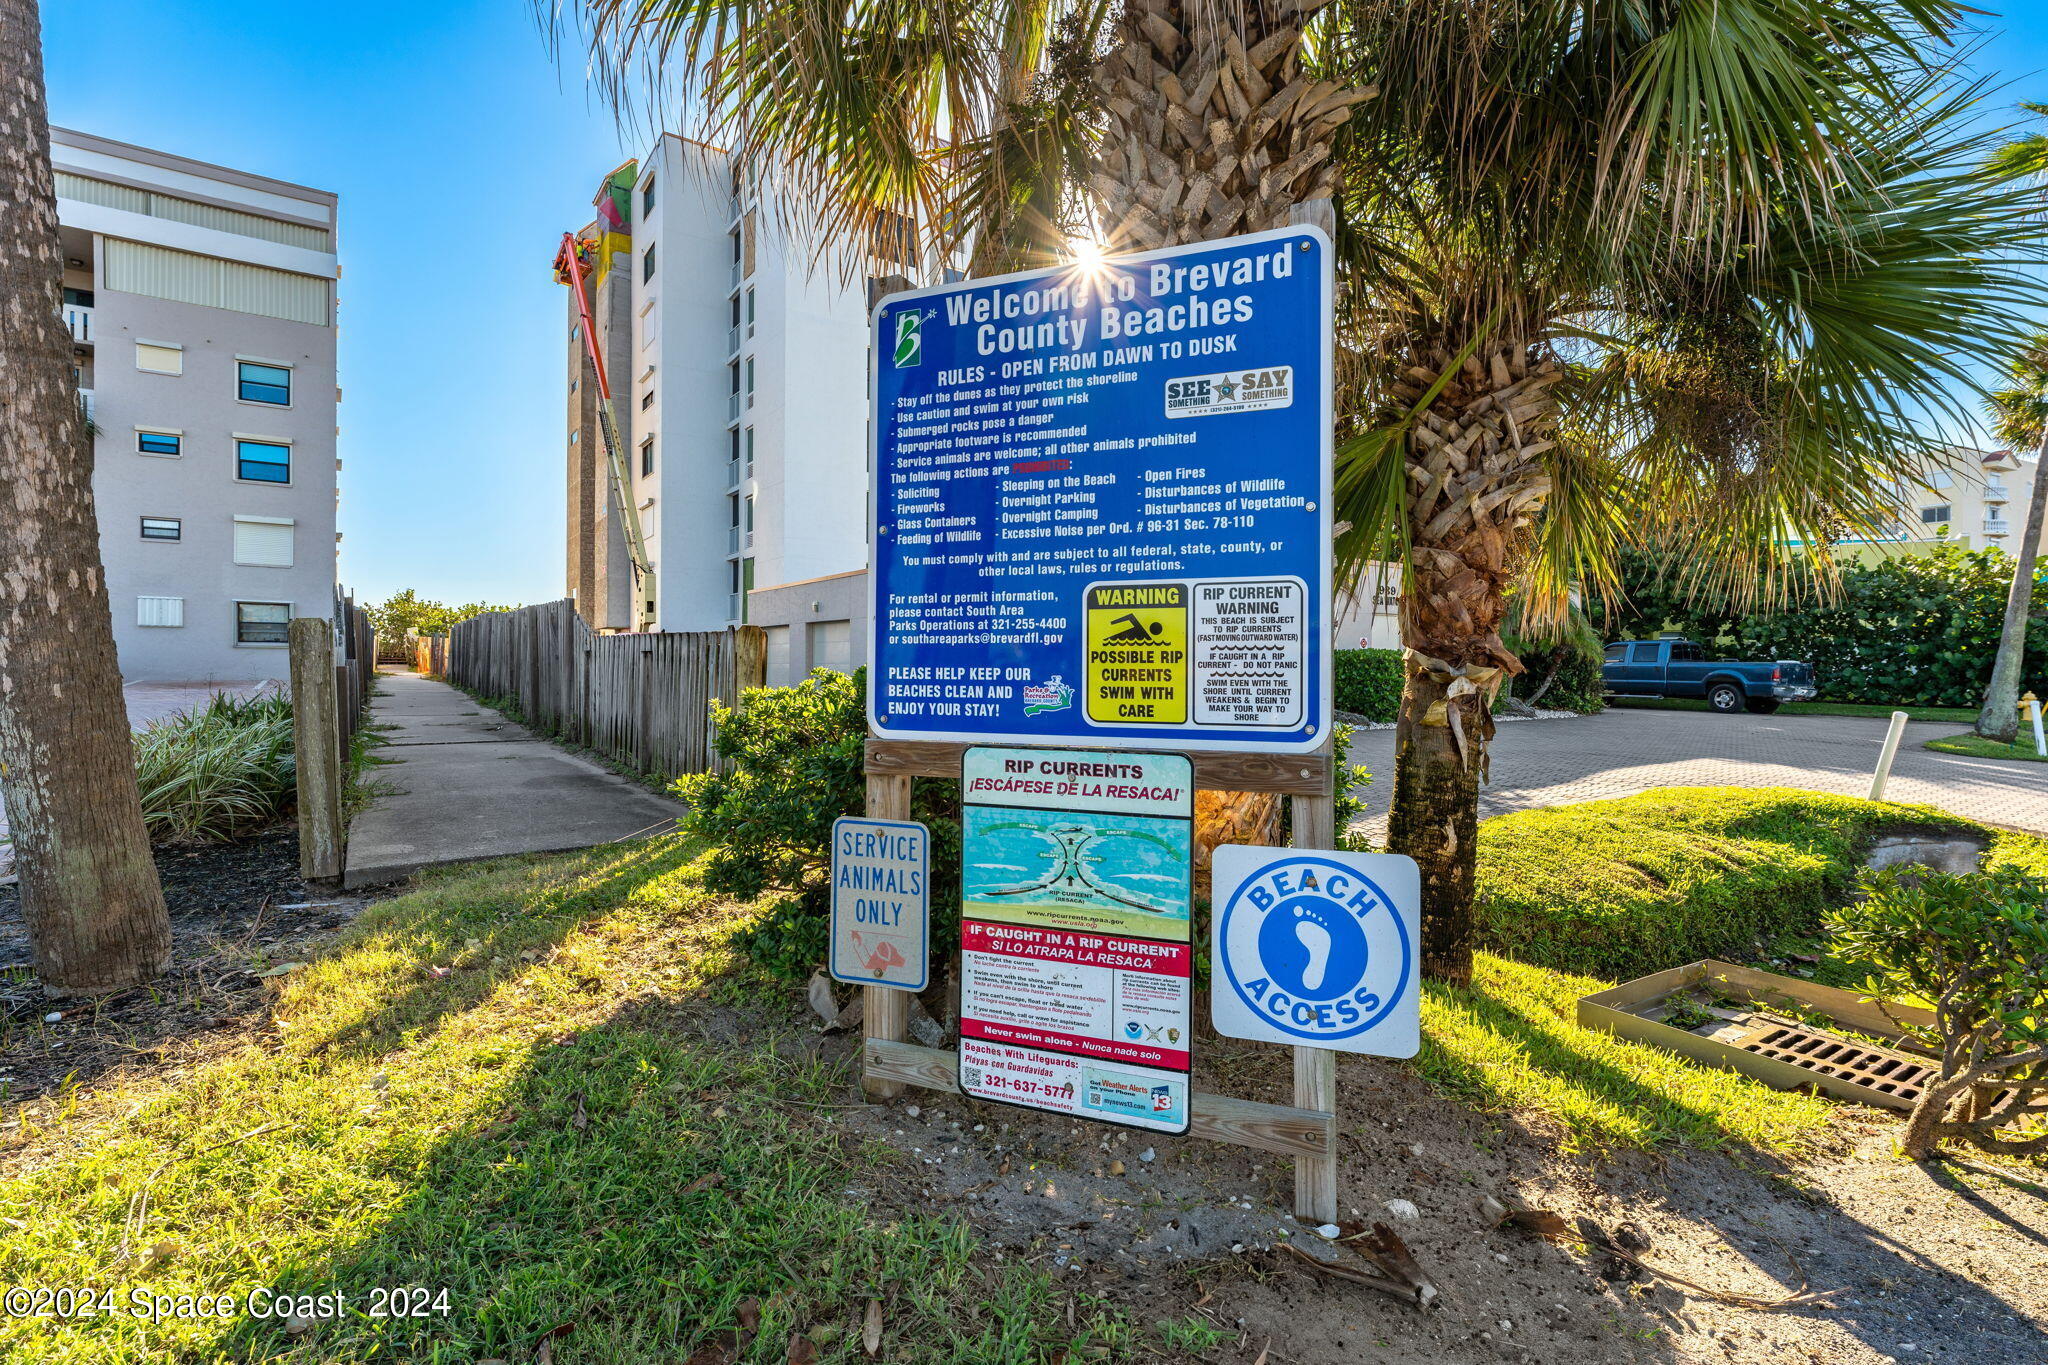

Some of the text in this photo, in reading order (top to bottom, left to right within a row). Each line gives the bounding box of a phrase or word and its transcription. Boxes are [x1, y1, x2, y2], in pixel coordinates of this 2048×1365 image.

[945, 242, 1292, 326] Welcome to Brevard
[977, 294, 1253, 355] County Beaches
[938, 333, 1236, 386] RULES OPEN FROM DAWN TO DUSK
[1241, 368, 1288, 390] SAY
[897, 370, 1137, 407] Stay off the dunes as they protect the shoreline
[1167, 379, 1210, 399] SEE
[1241, 387, 1287, 400] SOMETHING
[897, 391, 1088, 423] Use caution and swim at your own risk
[1168, 395, 1210, 408] SOMETHING
[1002, 472, 1115, 492] Sleeping on the Beach
[1144, 467, 1205, 483] Open Fires
[1144, 478, 1285, 498] Disturbances of Wildlife
[1002, 491, 1095, 507] Overnight Parking
[1144, 495, 1304, 515] Disturbances of Vegetation
[889, 589, 1058, 605] For rental or permit information,
[1095, 587, 1178, 605] WARNING
[1203, 585, 1291, 600] RIP CURRENT
[889, 604, 1023, 619] please contact South Area
[1216, 600, 1278, 614] WARNING
[889, 617, 1066, 632] Parks Operations at 321-255-4400
[1220, 616, 1245, 624] BEACH
[1249, 616, 1256, 624] IS
[1260, 615, 1294, 623] SUBJECT
[1213, 625, 1222, 633] TO
[1241, 624, 1281, 632] CURRENTS
[888, 631, 1062, 646] or southareaparks@brevardfl.gov
[1197, 633, 1298, 642] (FAST MOVING OUTWARD WATER)
[1091, 650, 1183, 663] POSSIBLE RIP
[1218, 652, 1247, 660] CAUGHT
[1250, 652, 1258, 660] IN
[1260, 652, 1266, 660] A
[888, 666, 1030, 680] PLEASE HELP KEEP OUR
[1101, 668, 1171, 681] CURRENTS
[888, 684, 1012, 698] BEACHES CLEAN AND
[1099, 685, 1173, 699] SWIM WITH
[888, 701, 999, 716] ENJOY YOUR STAY!
[1118, 703, 1154, 717] CARE
[1004, 759, 1143, 779] RIP CURRENTS
[969, 776, 1179, 801] ¡ESCÁPESE DE LA RESACA!
[843, 832, 918, 862] SERVICE
[840, 864, 920, 896] ANIMALS
[1055, 896, 1084, 904] (RESACA)
[1246, 868, 1378, 918] BEACH
[856, 898, 902, 926] ONLY
[1026, 910, 1124, 925] www.ripcurrents.noaa.gov
[970, 924, 1179, 957] IF CAUGHT IN A RIP CURRENT
[991, 940, 1151, 968] SI LO ATRAPA LA RESACA
[1244, 976, 1380, 1028] ACCESS
[984, 1025, 1161, 1060] Never swim alone Nunca nade solo
[964, 1041, 1078, 1068] Beaches With Lifeguards:
[964, 1054, 1053, 1077] Playas con Guardavidas
[1101, 1079, 1127, 1090] Weather
[1128, 1083, 1147, 1093] Alerts
[1115, 1088, 1135, 1096] Phone
[1103, 1098, 1145, 1110] mynews13.com
[1153, 1094, 1171, 1108] 13
